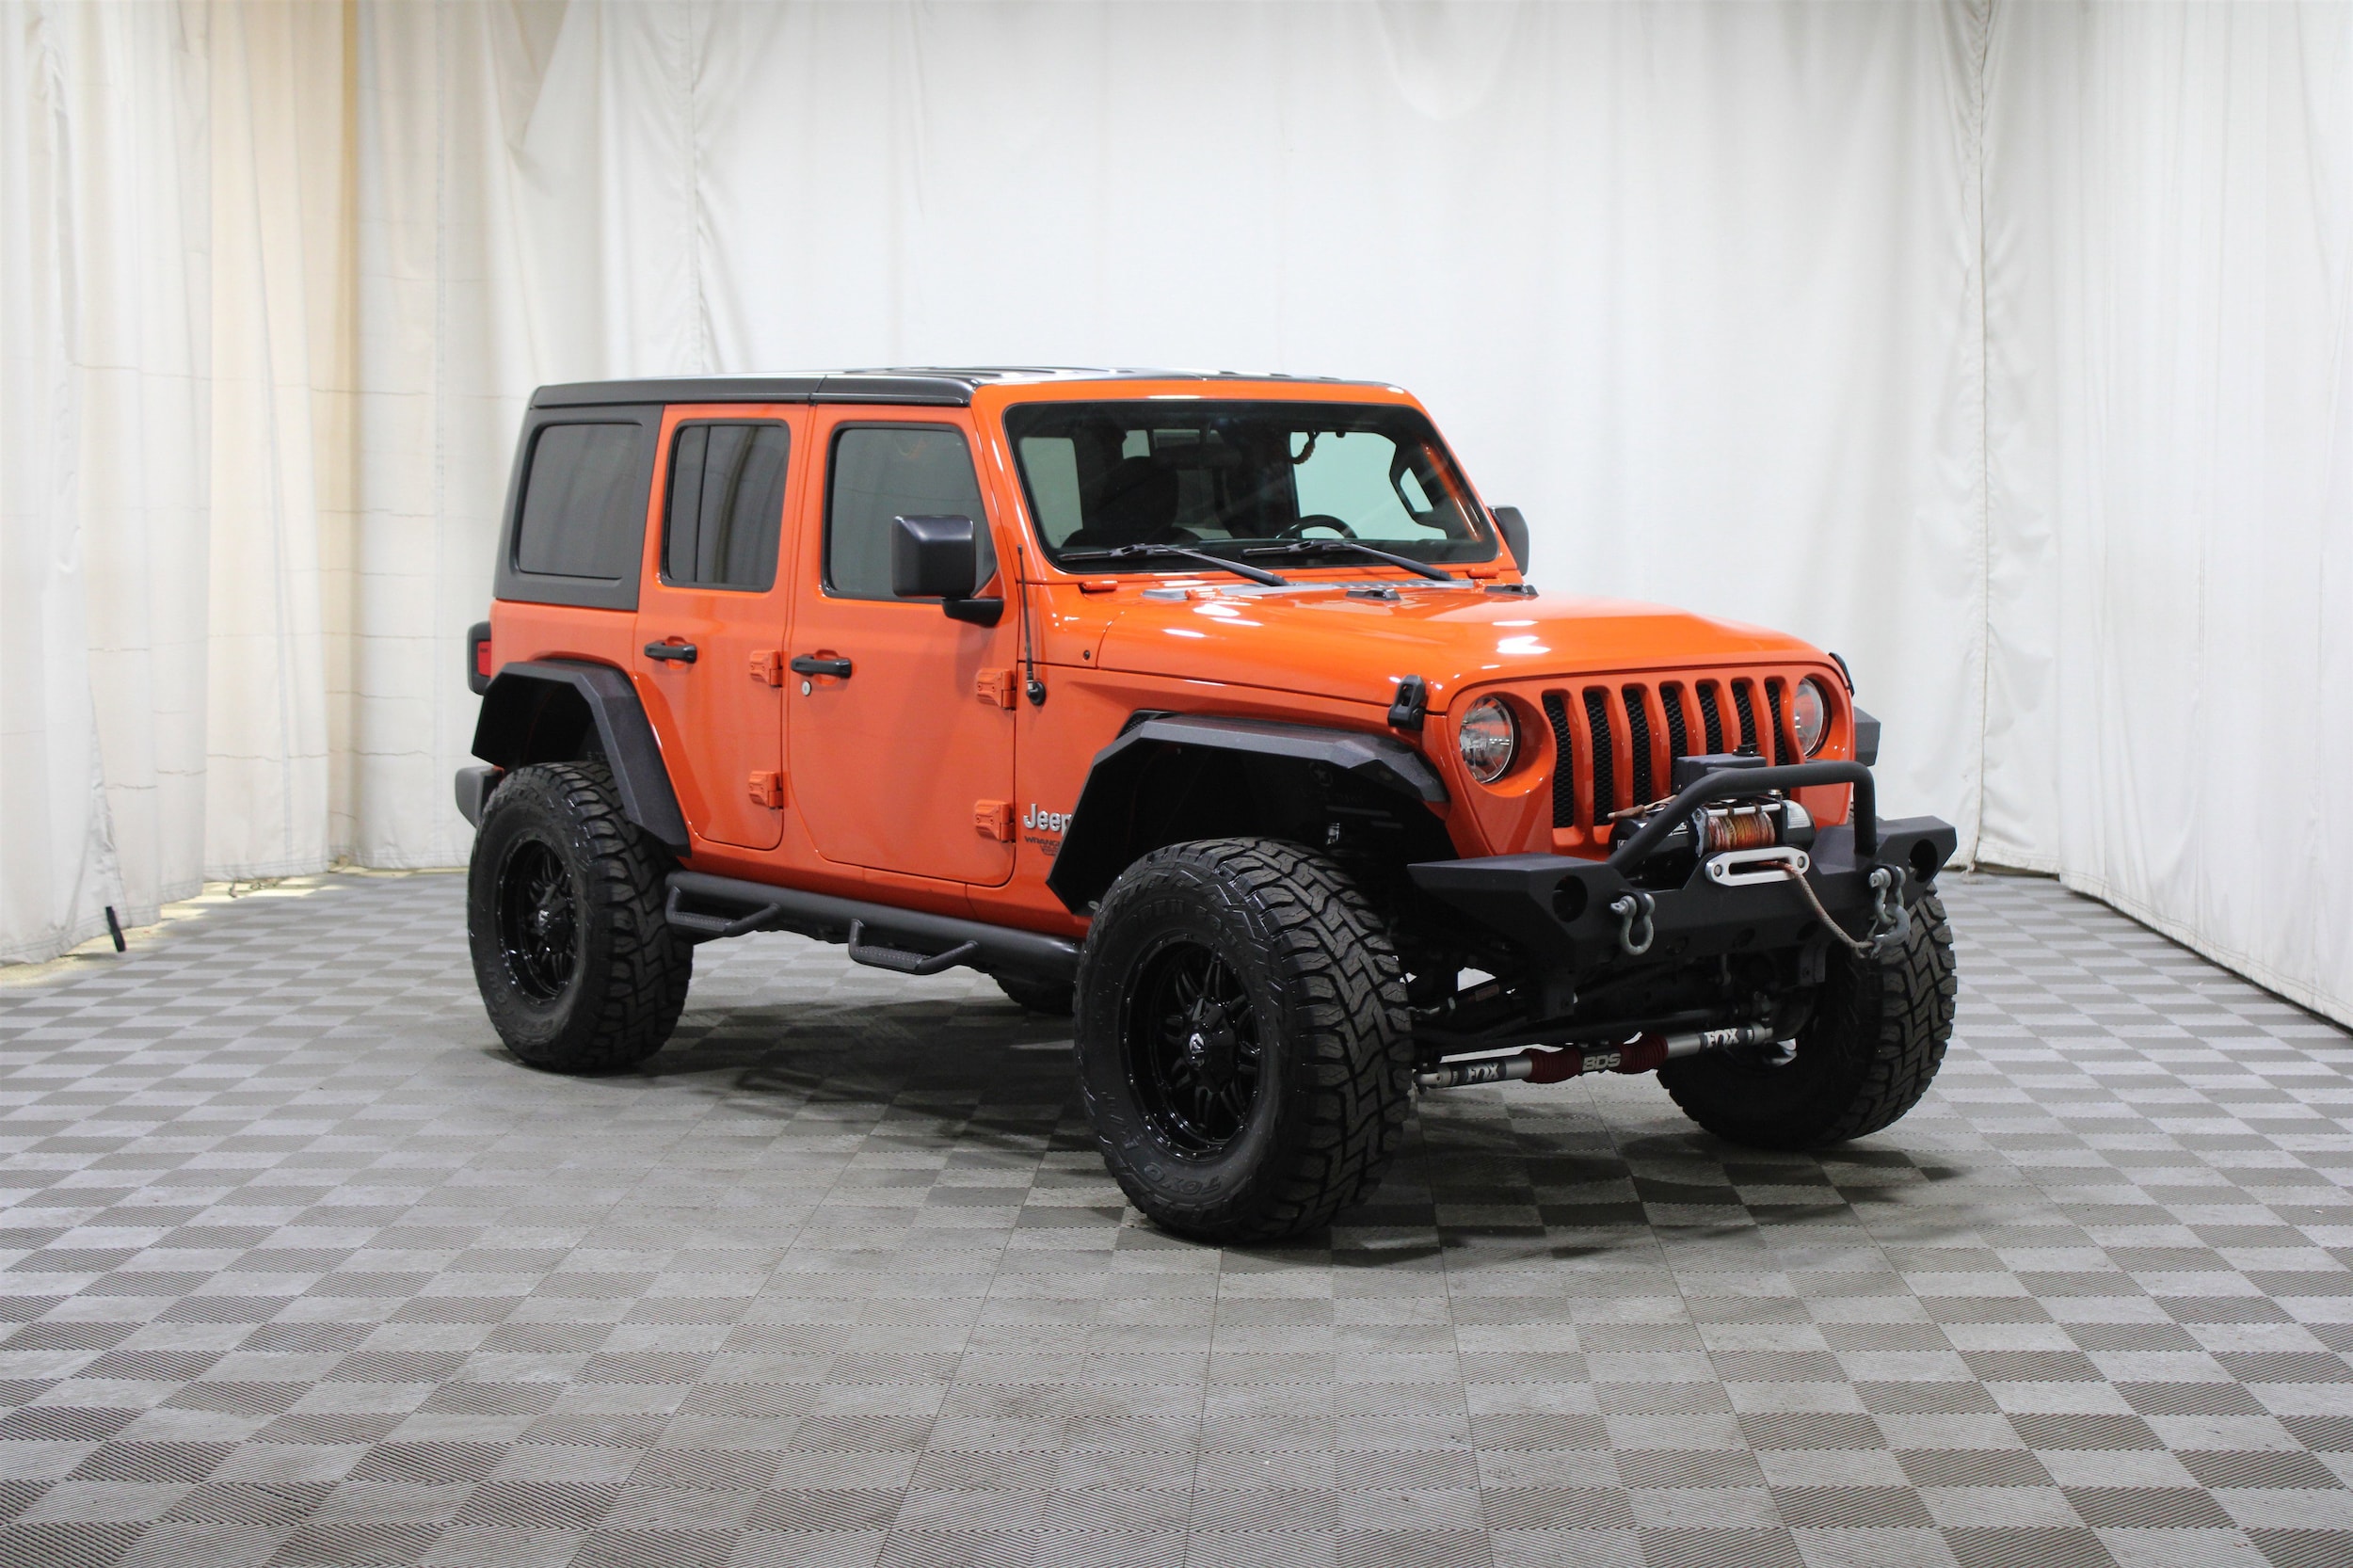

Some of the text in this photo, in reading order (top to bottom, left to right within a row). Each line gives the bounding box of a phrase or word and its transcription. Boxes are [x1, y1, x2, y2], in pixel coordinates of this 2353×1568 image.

[1024, 836, 1061, 846] WRANG
[1704, 1028, 1739, 1048] FOX
[1582, 1052, 1622, 1071] BDS
[1466, 1062, 1499, 1082] FOX
